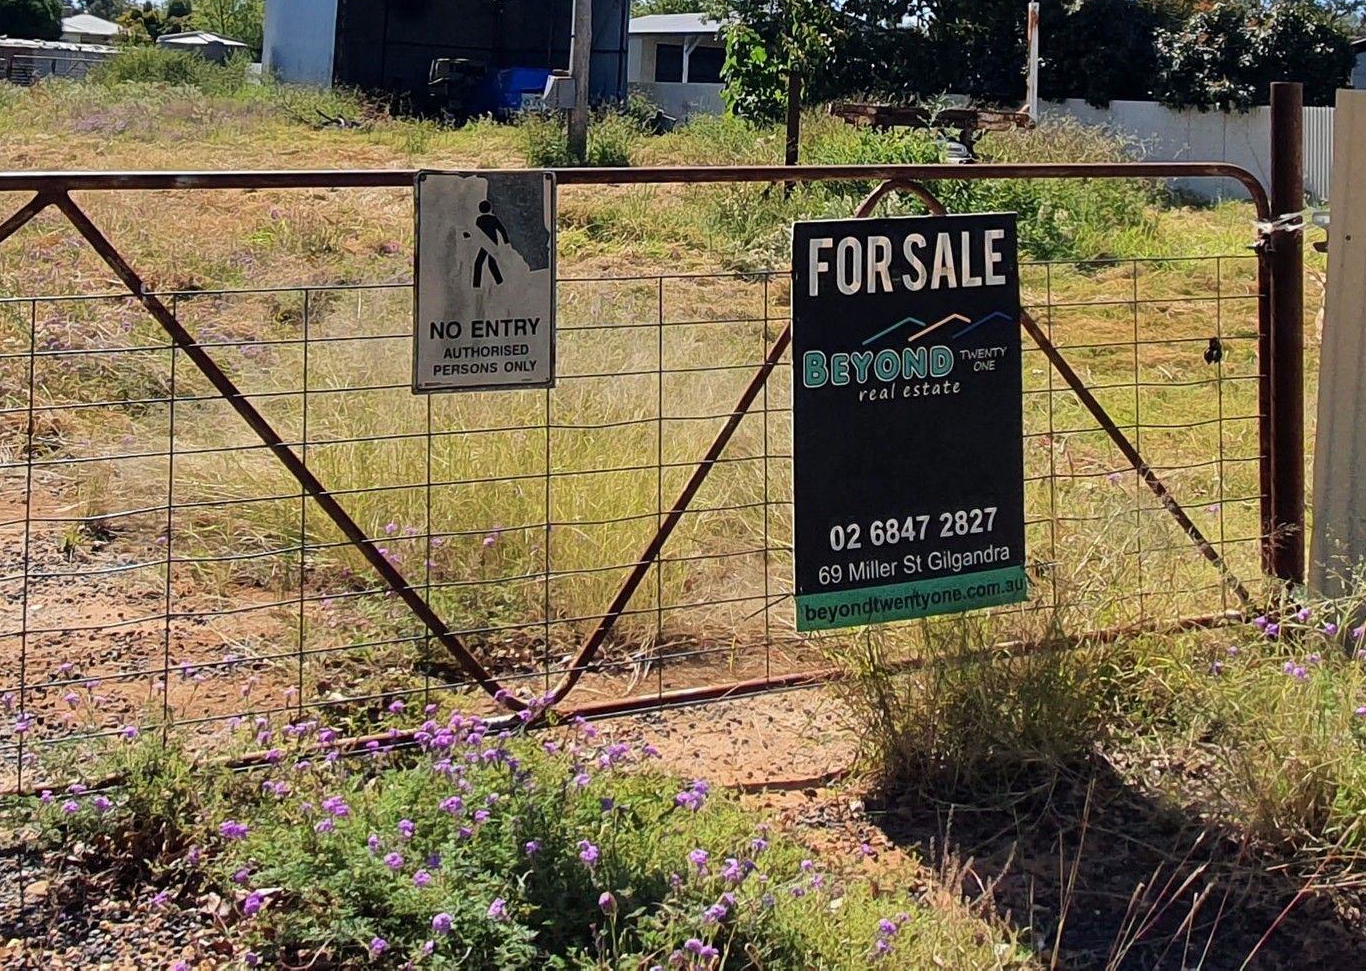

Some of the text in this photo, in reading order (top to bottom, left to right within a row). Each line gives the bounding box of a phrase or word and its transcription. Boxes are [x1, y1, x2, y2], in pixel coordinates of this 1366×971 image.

[808, 229, 1006, 296] FOR SALE
[430, 317, 540, 340] NO ENTRY
[443, 344, 529, 359] AUTHORISED
[960, 347, 1008, 360] TWENTY
[433, 360, 537, 376] PERSONS ONLY
[803, 345, 954, 388] BEYOND
[973, 361, 996, 372] ONE
[858, 379, 961, 402] real estate
[830, 507, 998, 552] 02 6847 2827
[818, 543, 1010, 586] 69 Miller St Gilgandra
[805, 577, 1024, 623] beyondtwentyone.com.au
